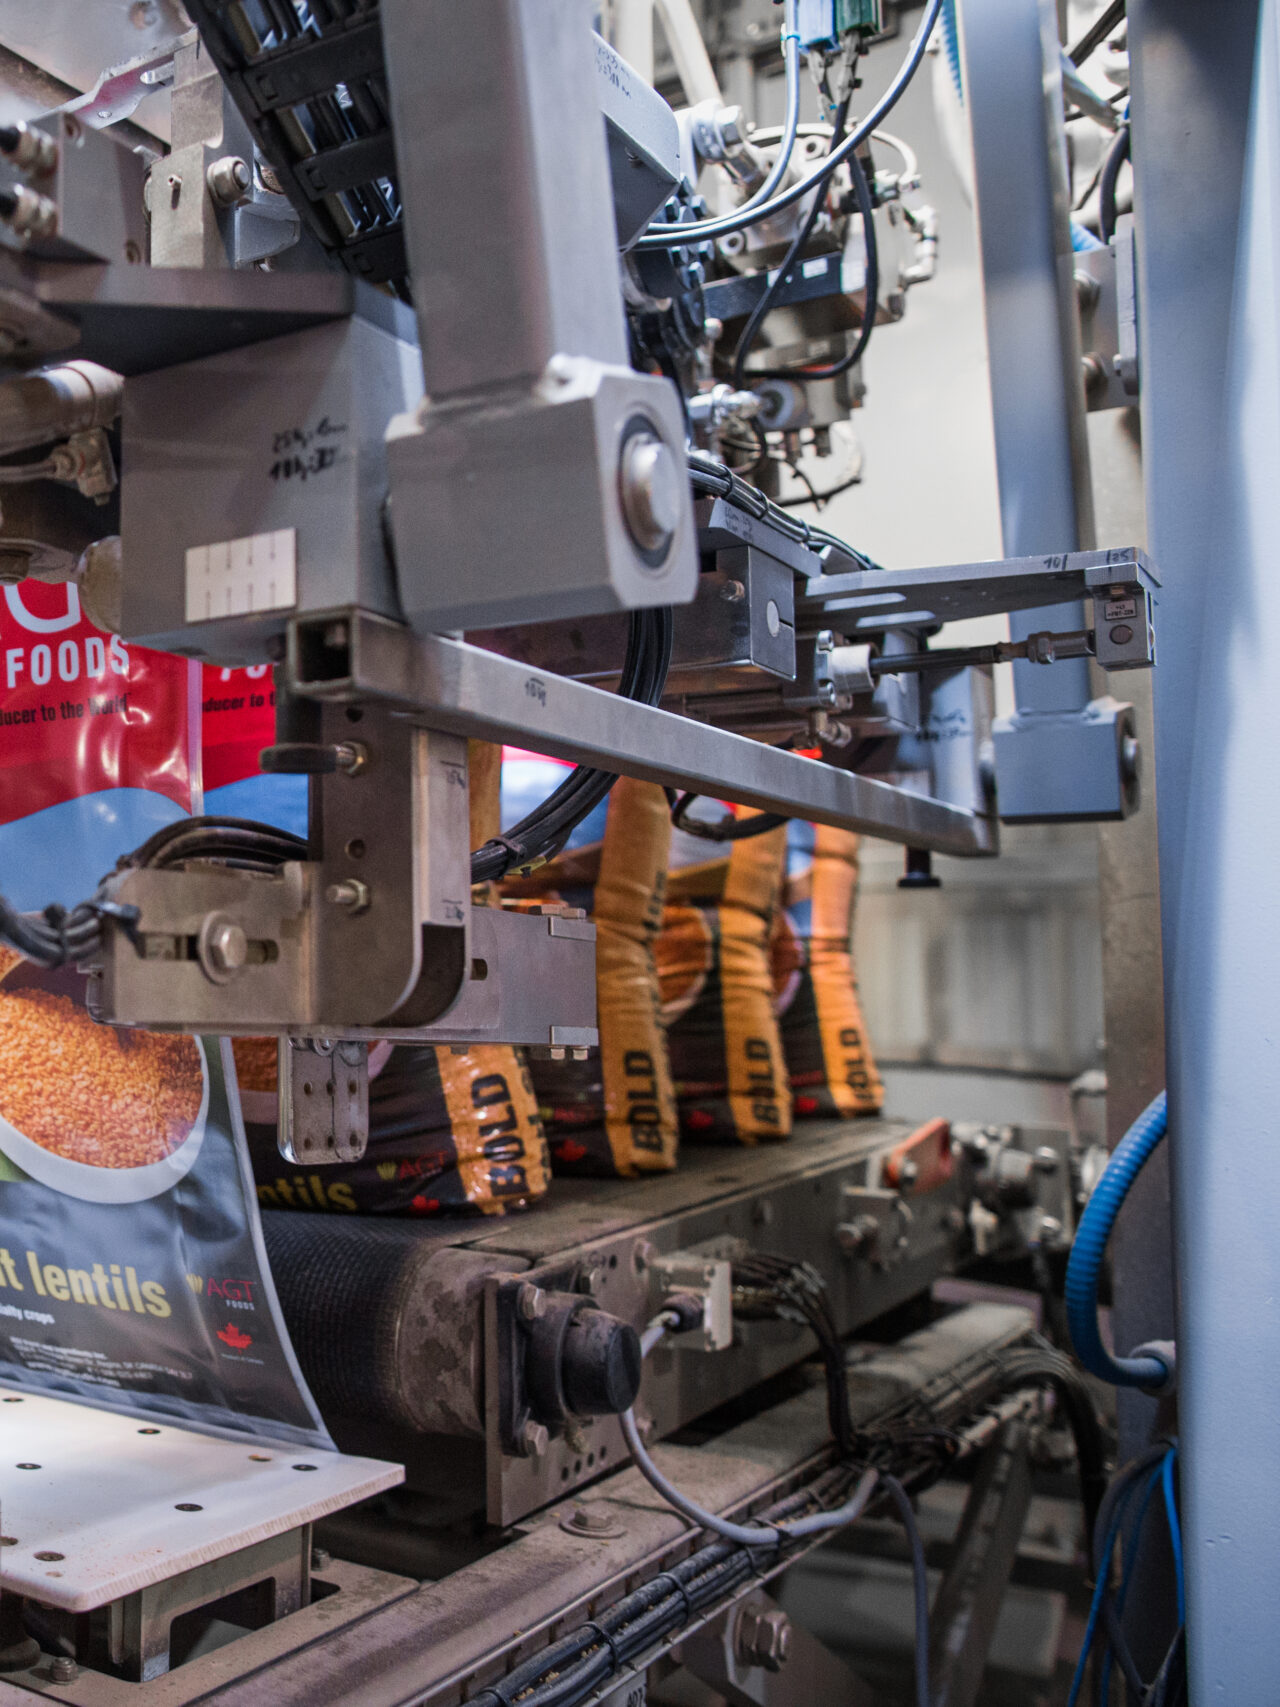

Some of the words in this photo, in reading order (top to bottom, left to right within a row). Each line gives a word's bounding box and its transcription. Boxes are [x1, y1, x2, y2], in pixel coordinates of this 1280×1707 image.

[6, 633, 130, 688] FOODS
[41, 705, 56, 722] to
[60, 701, 84, 719] the
[88, 693, 129, 716] World
[250, 694, 264, 708] to
[624, 1050, 665, 1153] BOLD
[471, 1073, 530, 1197] BOLD
[399, 1151, 448, 1180] AGT
[256, 1175, 358, 1211] ntils
[26, 1251, 171, 1318] lentils
[207, 1278, 254, 1302] AGT
